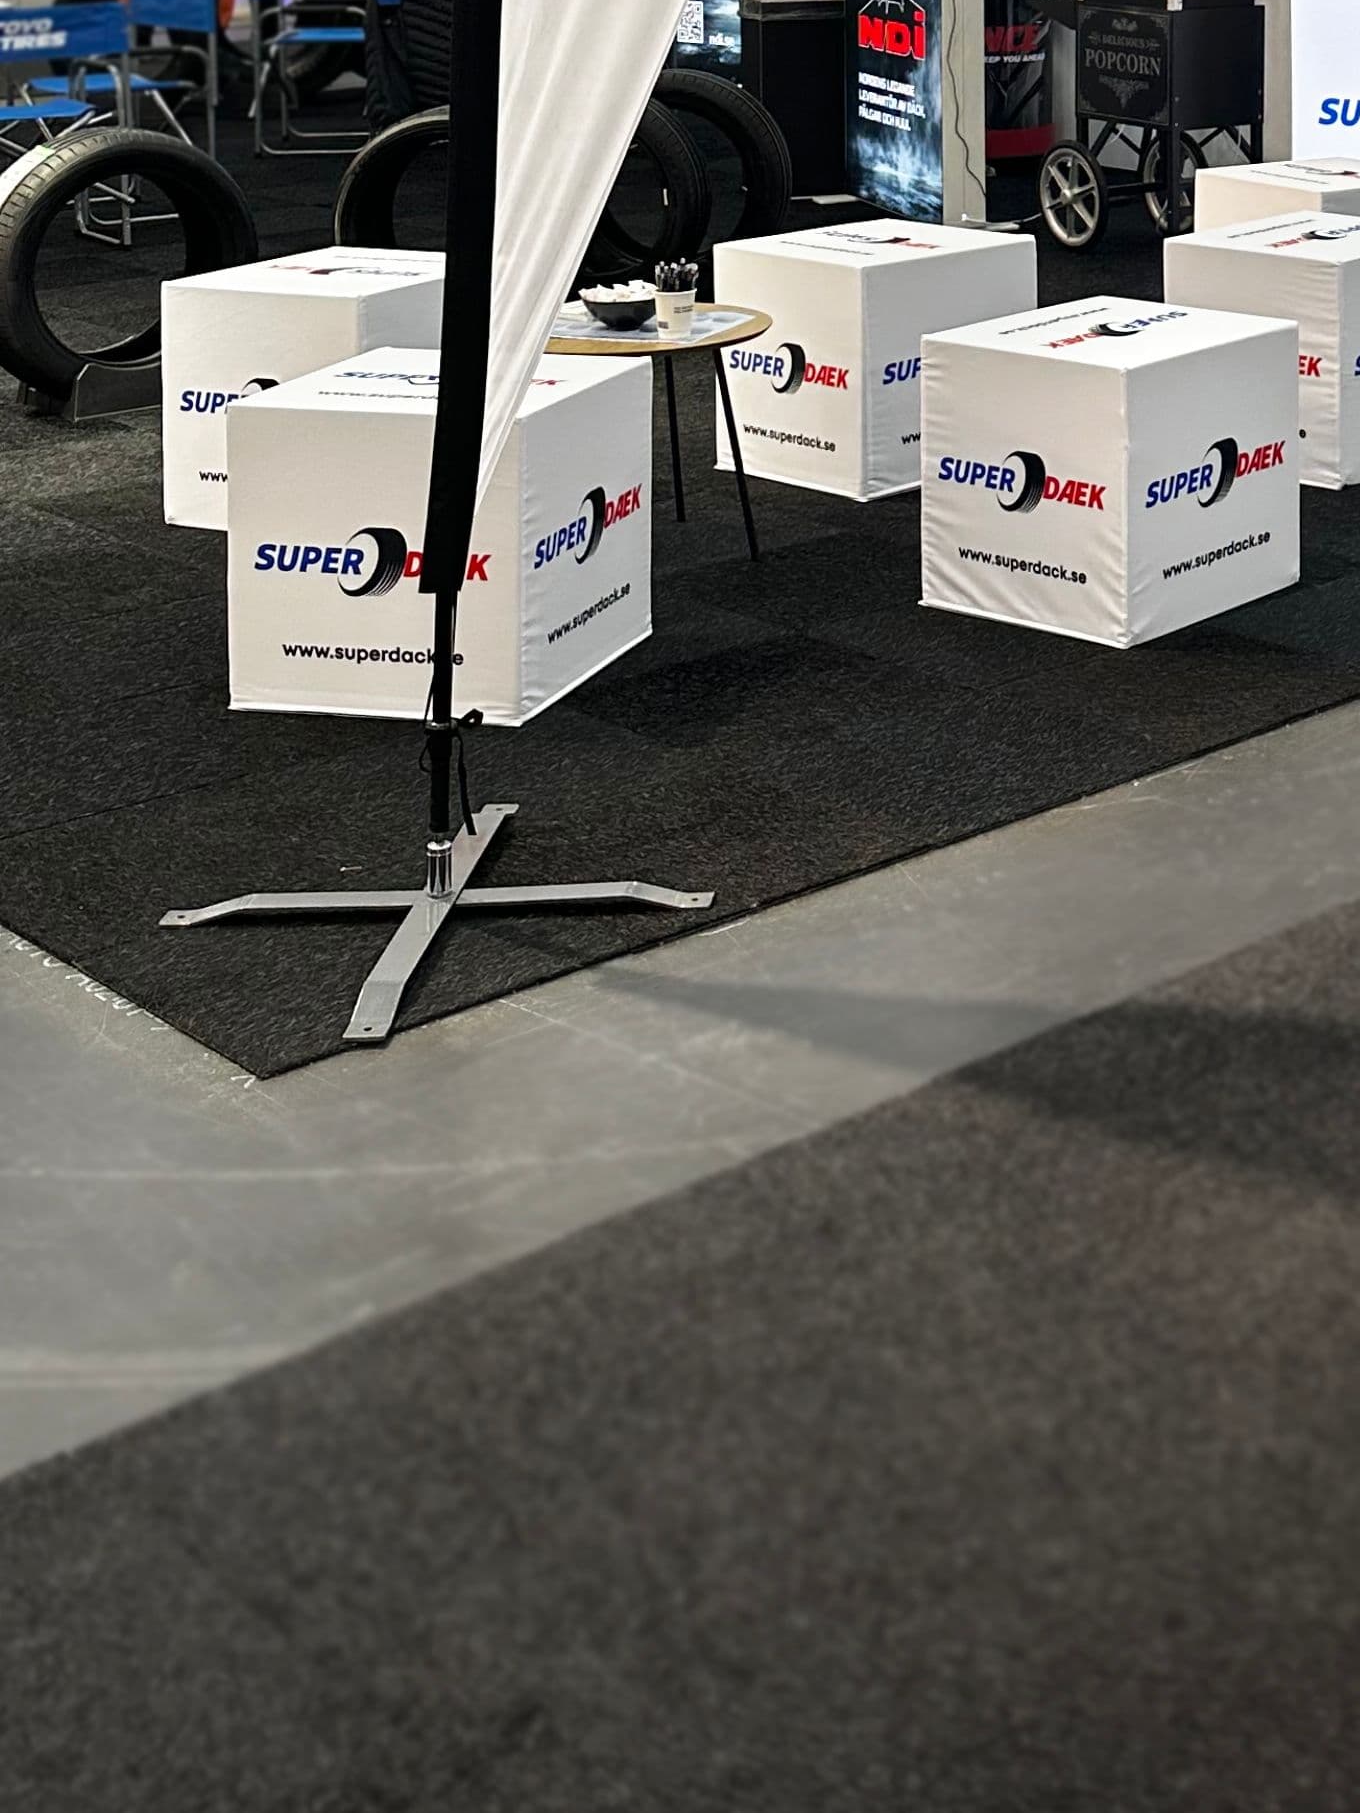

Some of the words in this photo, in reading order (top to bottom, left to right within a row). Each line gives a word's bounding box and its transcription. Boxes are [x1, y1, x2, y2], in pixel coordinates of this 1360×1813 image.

[1085, 48, 1161, 76] POPCORN
[729, 349, 784, 377] SUPER
[804, 361, 849, 390] DAEK
[743, 423, 836, 452] www.superdack.se
[938, 456, 1016, 493] SUPER
[1042, 475, 1108, 511] DAEK
[1145, 463, 1214, 508] SUPER
[1235, 440, 1286, 477] DAEK
[534, 516, 588, 569] SUPER
[603, 482, 642, 529] DAEK
[255, 543, 365, 575] SUPER
[404, 550, 491, 582] DK
[959, 545, 1087, 585] www.superdack.se
[1162, 530, 1271, 580] www.superdack.se
[547, 582, 631, 645] www.superdack.se
[283, 640, 464, 669] www.superdacke
